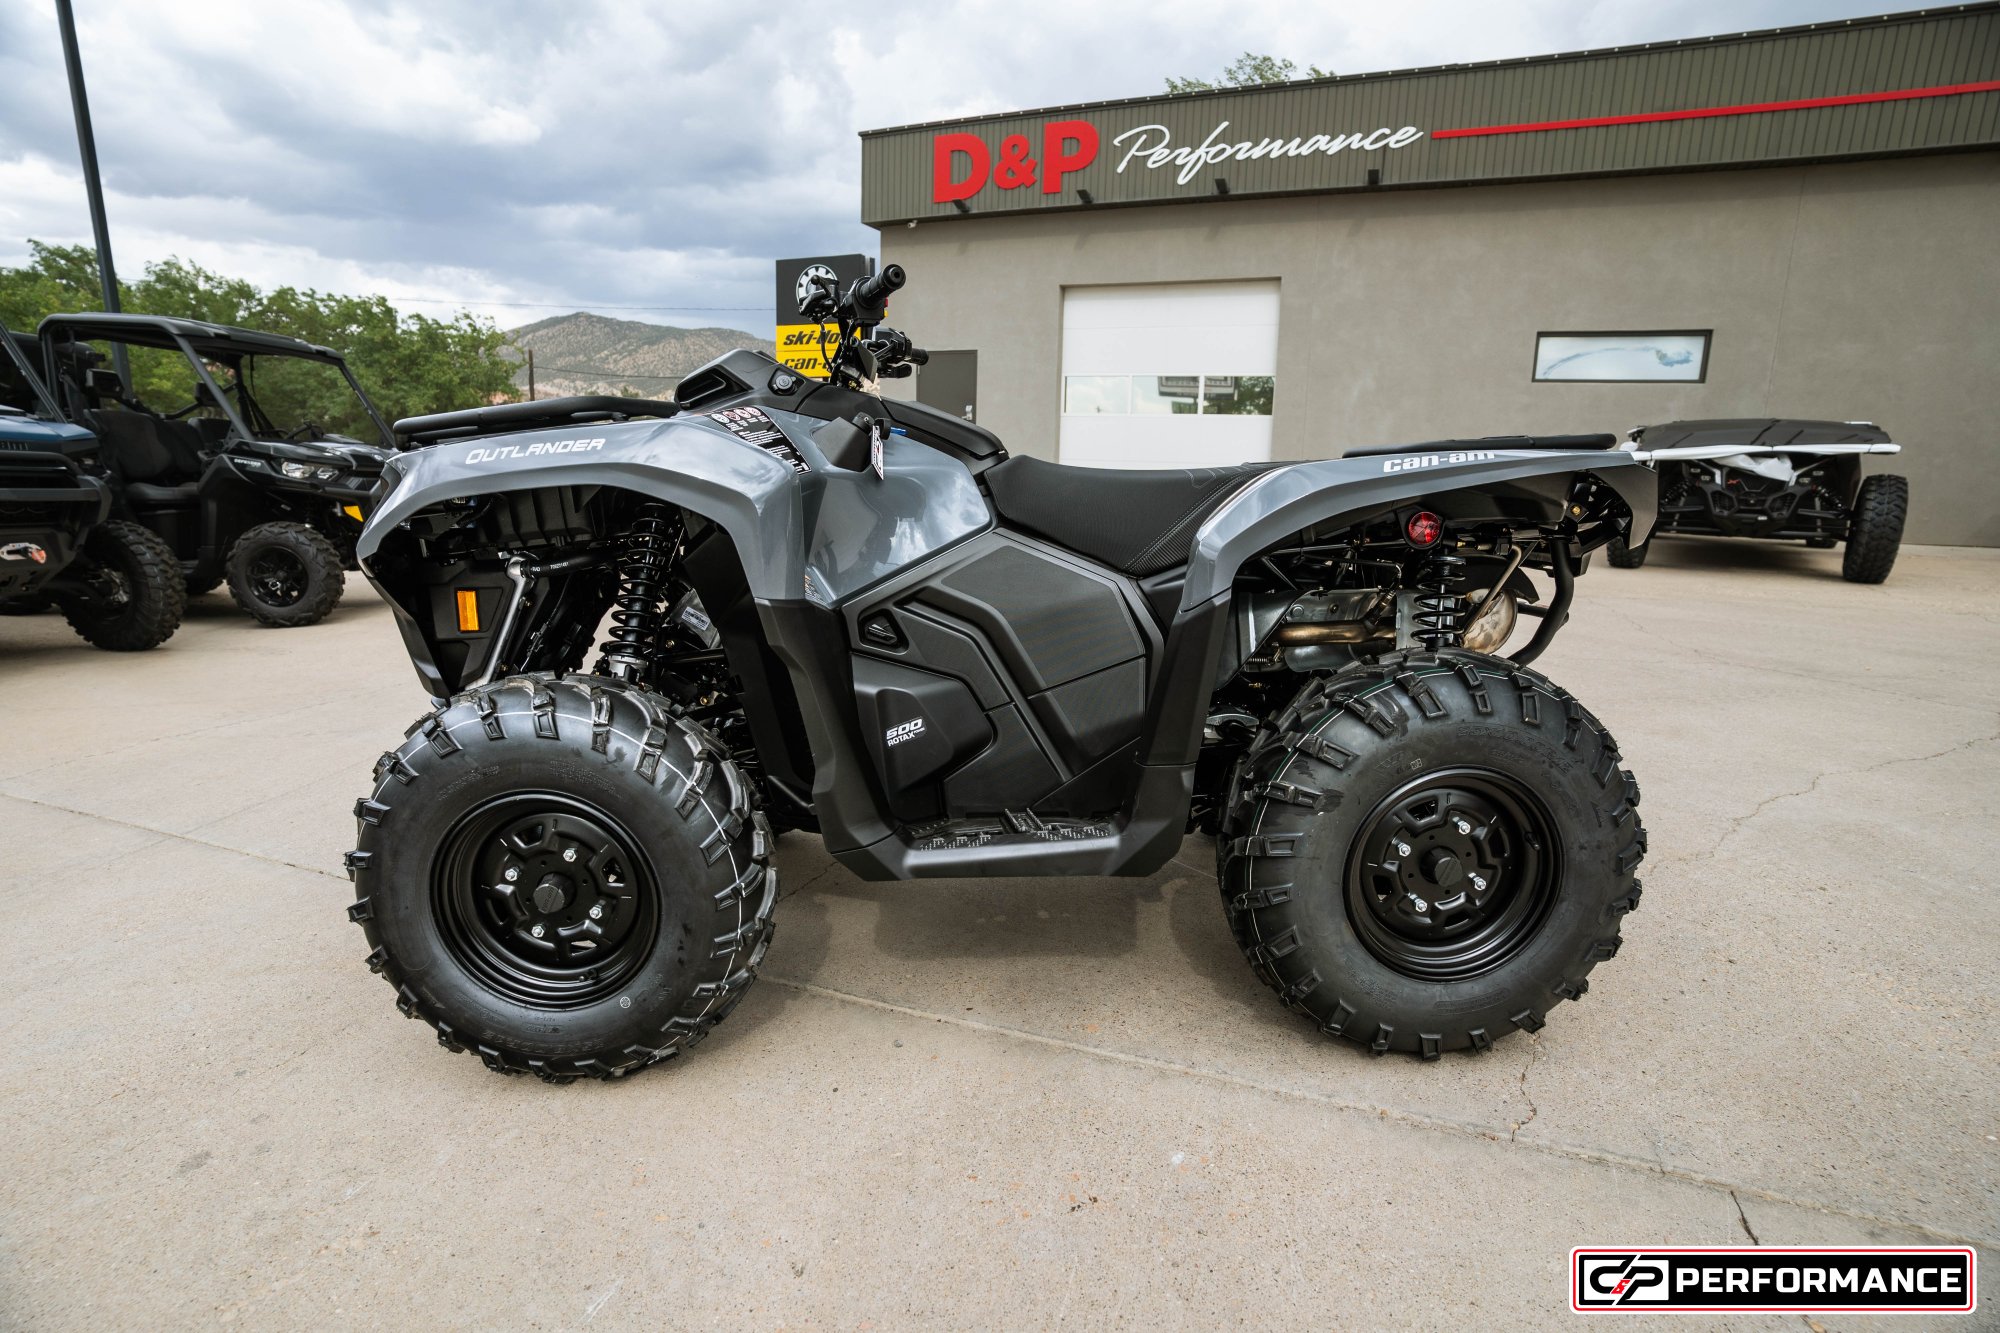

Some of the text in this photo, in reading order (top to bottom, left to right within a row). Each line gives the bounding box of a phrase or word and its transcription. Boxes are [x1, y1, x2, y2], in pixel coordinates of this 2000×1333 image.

[933, 120, 1424, 203] D&P Performance
[784, 330, 841, 346] ski-do
[465, 438, 606, 465] OUTLANDER
[1383, 452, 1495, 473] can-am
[886, 718, 923, 740] 500
[887, 731, 916, 747] ROTAX
